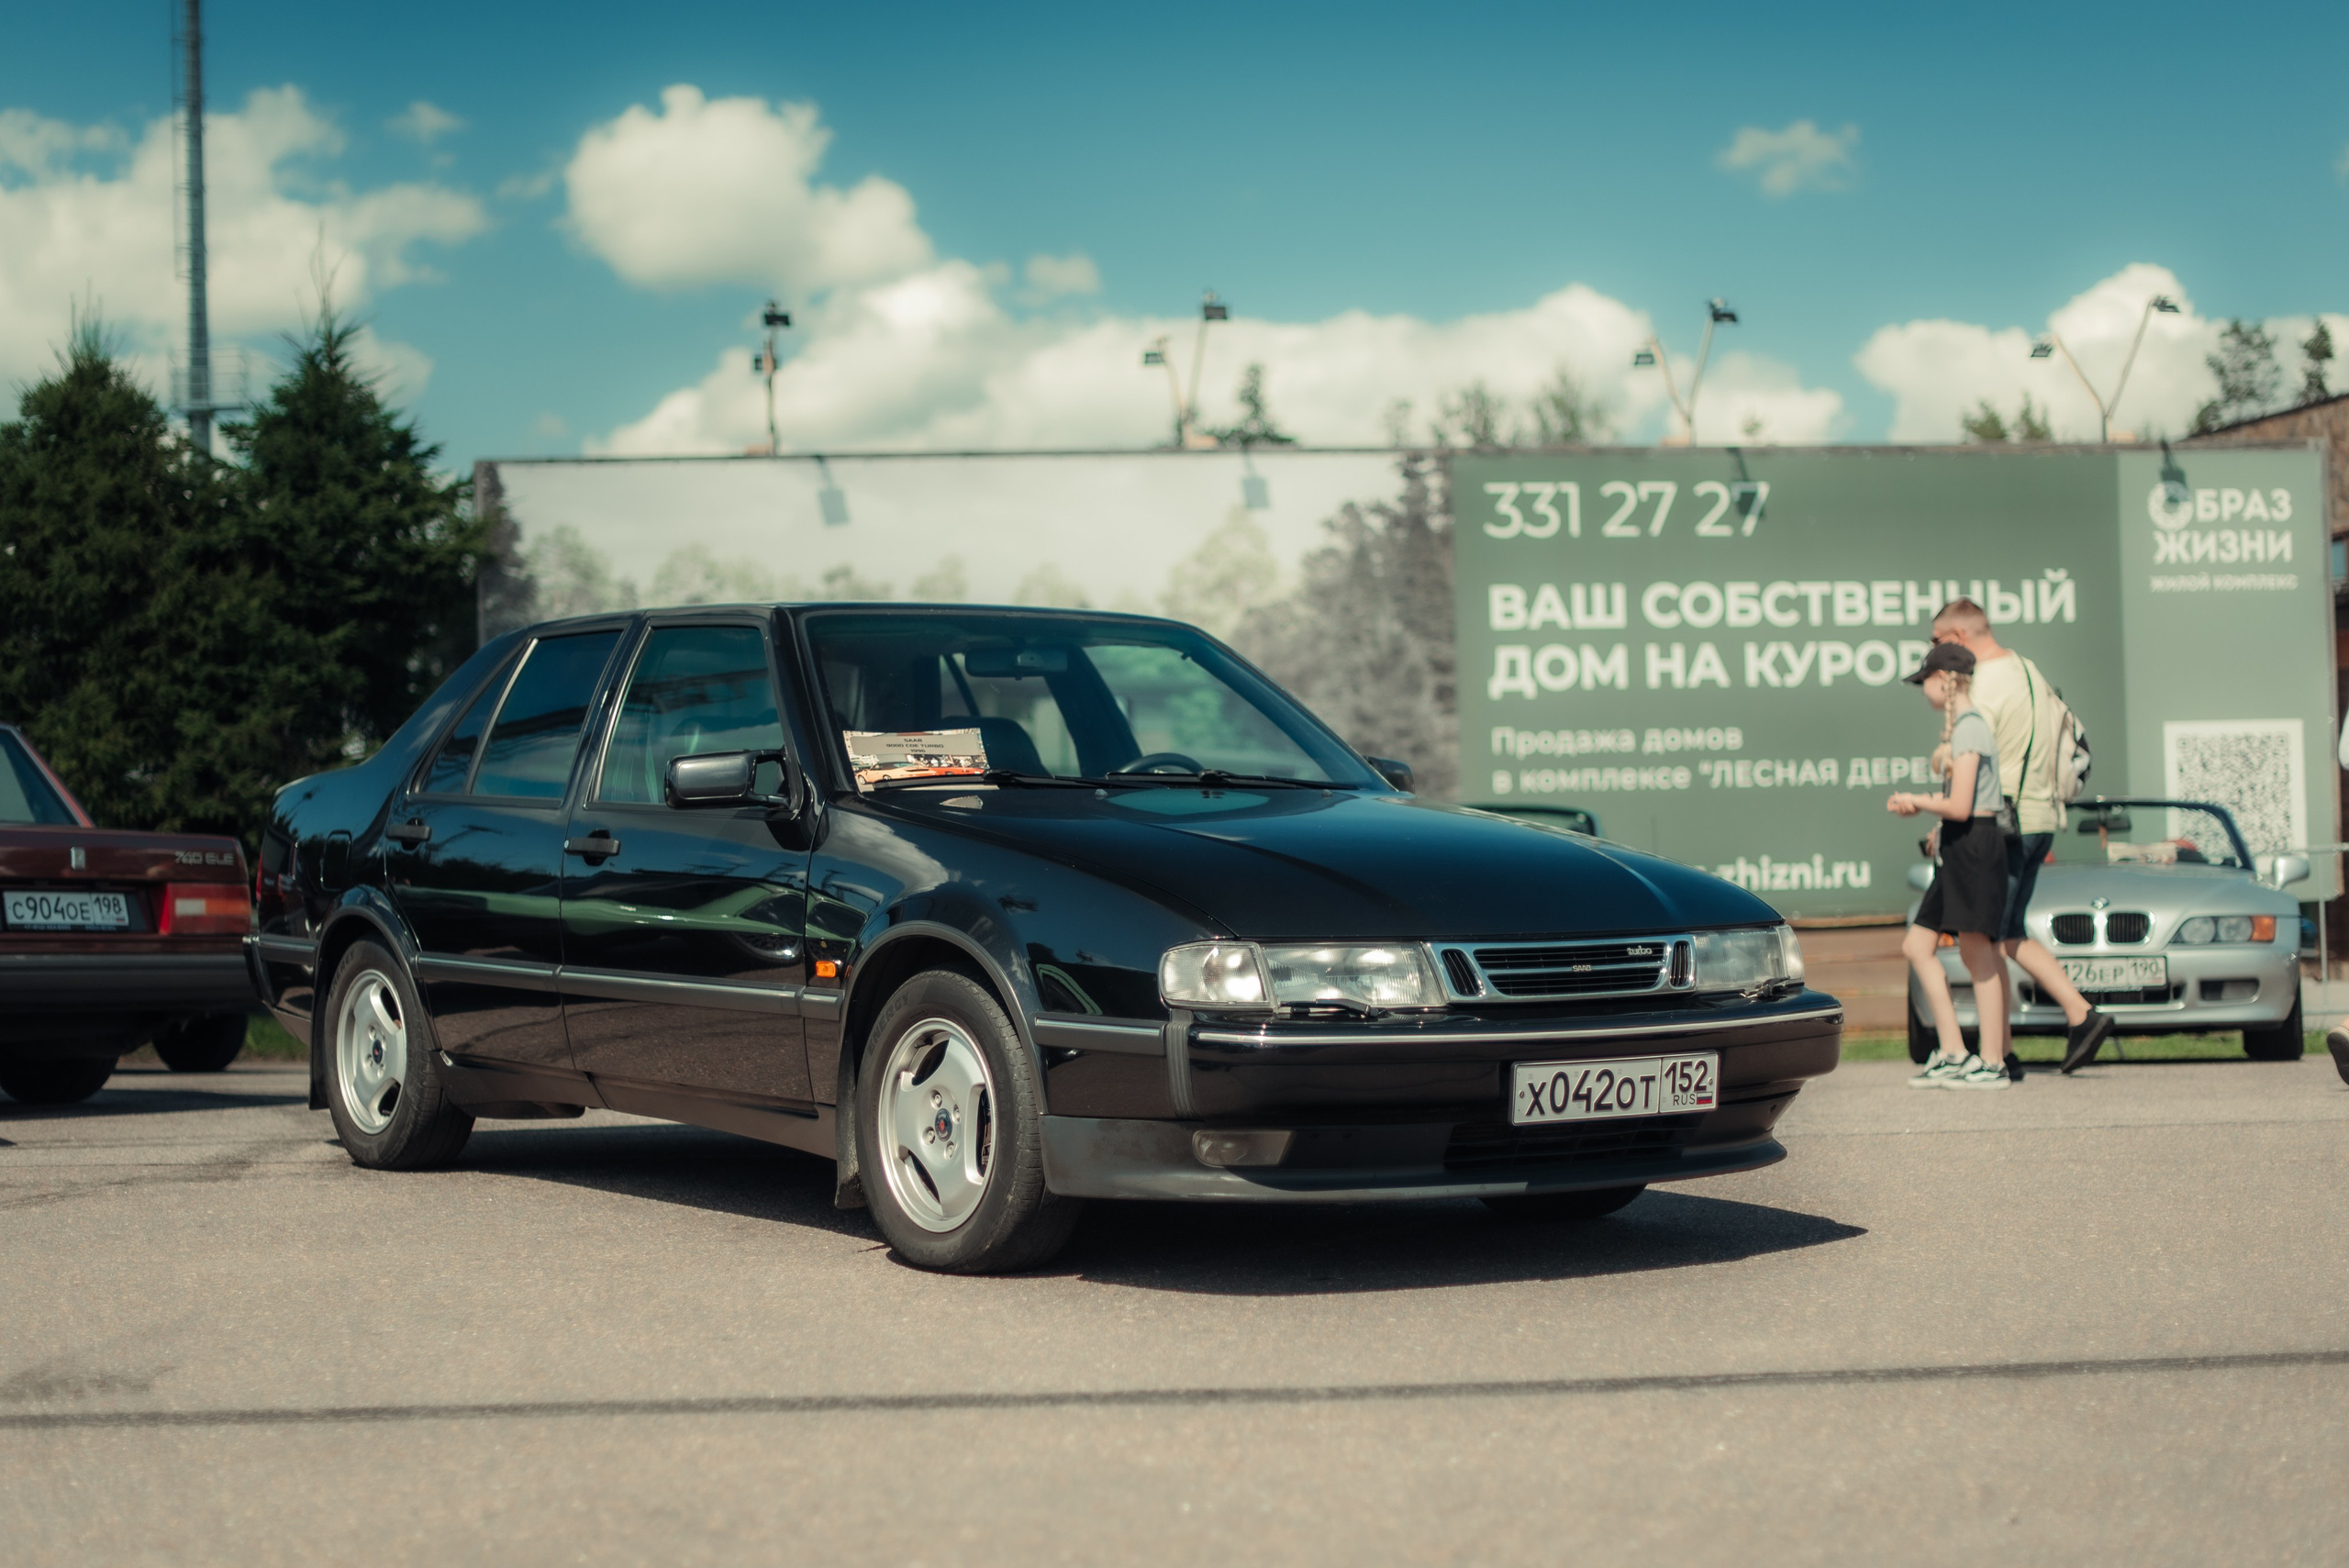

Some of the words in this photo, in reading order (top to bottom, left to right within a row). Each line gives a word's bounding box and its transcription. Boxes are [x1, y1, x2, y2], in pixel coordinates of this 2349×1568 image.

[1483, 481, 1582, 539] 331
[1600, 481, 1677, 538] 27
[1694, 481, 1772, 537] 27
[2148, 480, 2293, 531] ОБРАЗ
[2152, 528, 2293, 564] ЖИЗНИ
[1487, 582, 1627, 630] ВАШ
[1486, 643, 1628, 700] ДОМ
[1645, 642, 1731, 689] НА
[1744, 639, 1932, 687] КУРОР
[1490, 726, 1637, 760] Продажа
[1642, 727, 1743, 755] домов
[1492, 770, 1512, 795] в
[1520, 765, 1692, 794] комплексе
[1696, 852, 1872, 892] zhizni.ru
[94, 895, 123, 916] 198
[1627, 945, 1653, 956] turbo
[2062, 962, 2124, 984] 126ЕР
[866, 991, 910, 1056] ENERGY
[1525, 1068, 1656, 1117] Х042ОТ
[1664, 1060, 1709, 1095] 152
[1673, 1094, 1696, 1106] RUS
